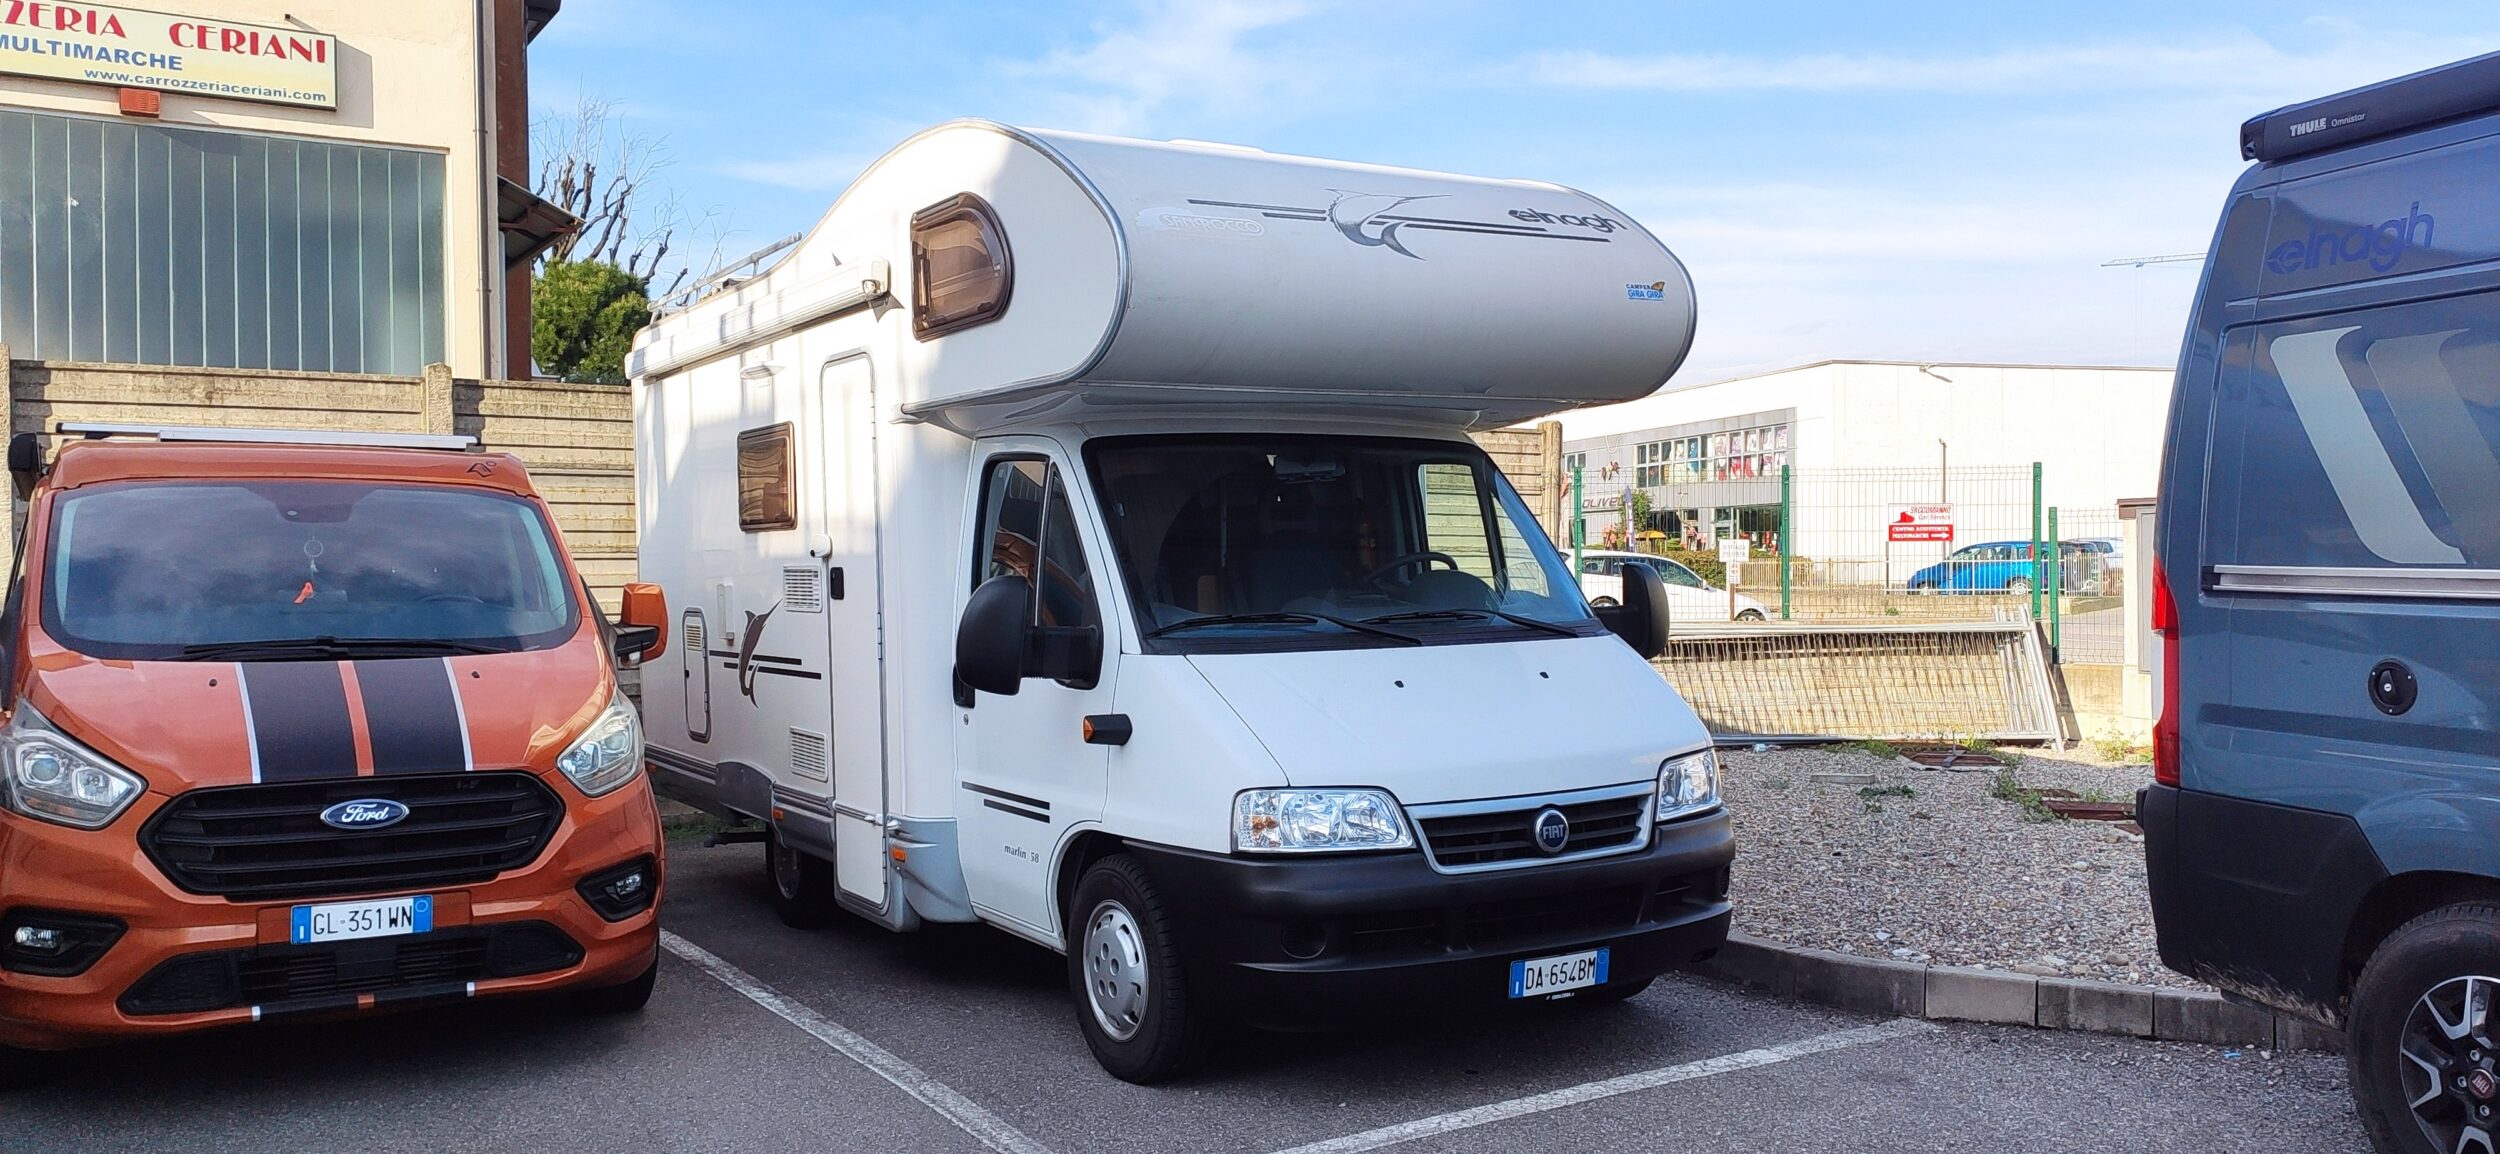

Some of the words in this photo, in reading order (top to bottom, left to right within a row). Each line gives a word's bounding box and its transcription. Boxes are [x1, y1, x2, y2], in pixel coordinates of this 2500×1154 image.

[0, 0, 127, 39] ZERIA
[169, 22, 327, 64] CERIANI
[84, 69, 327, 102] www.carrozzeriaceriani.com
[2290, 117, 2327, 137] THULE
[2331, 113, 2366, 128] Omnistor
[1508, 207, 1628, 233] elnagh
[2267, 201, 2435, 275] elnagh
[1628, 289, 1645, 298] GIRA
[1646, 290, 1664, 299] GIRA
[341, 803, 389, 823] Ford
[1542, 824, 1565, 840] FIAT
[1004, 845, 1027, 860] marlin
[1030, 851, 1040, 864] 58
[2471, 1074, 2490, 1094] FIAT
